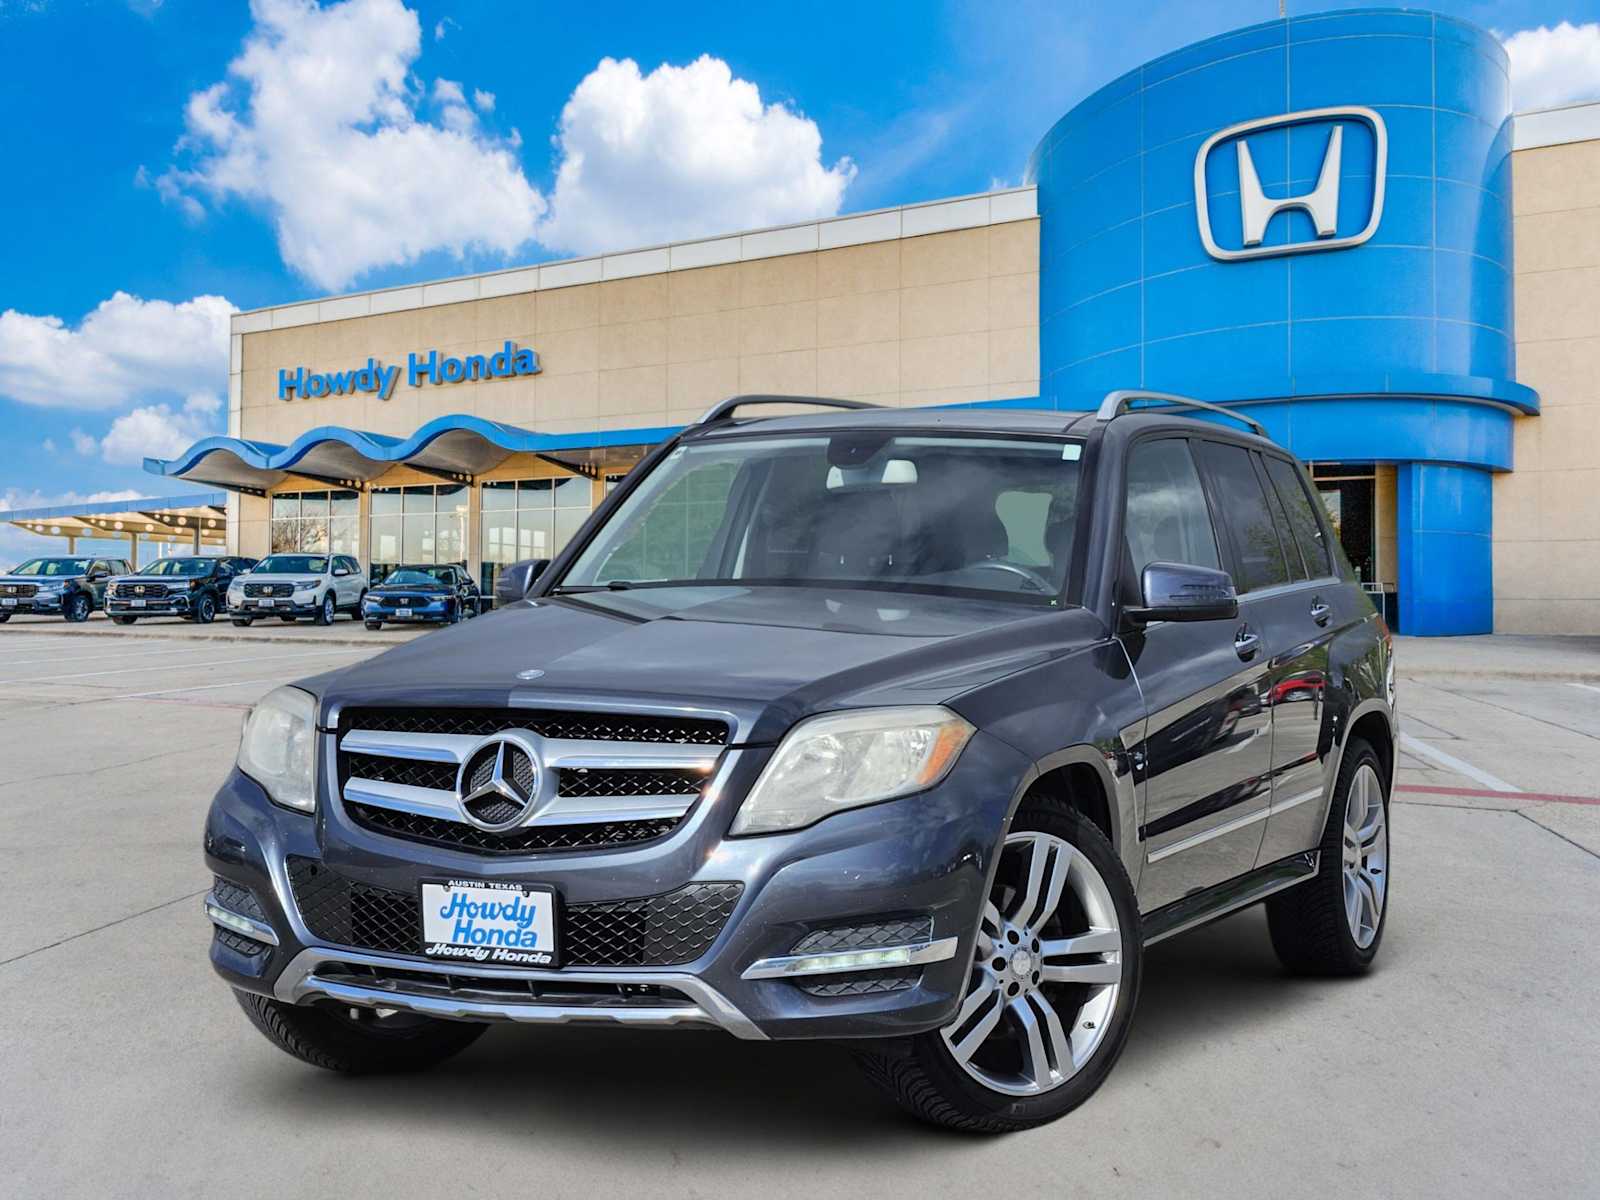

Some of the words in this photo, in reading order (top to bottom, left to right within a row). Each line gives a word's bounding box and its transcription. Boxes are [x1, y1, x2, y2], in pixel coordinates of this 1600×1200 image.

[278, 358, 400, 400] Howdy
[407, 341, 541, 388] Honda
[448, 879, 485, 889] AUSTIN
[488, 882, 523, 891] TEXAS
[440, 893, 536, 928] Howdy
[452, 918, 537, 948] Honda
[425, 943, 490, 961] Howdy
[491, 948, 552, 964] Honda
